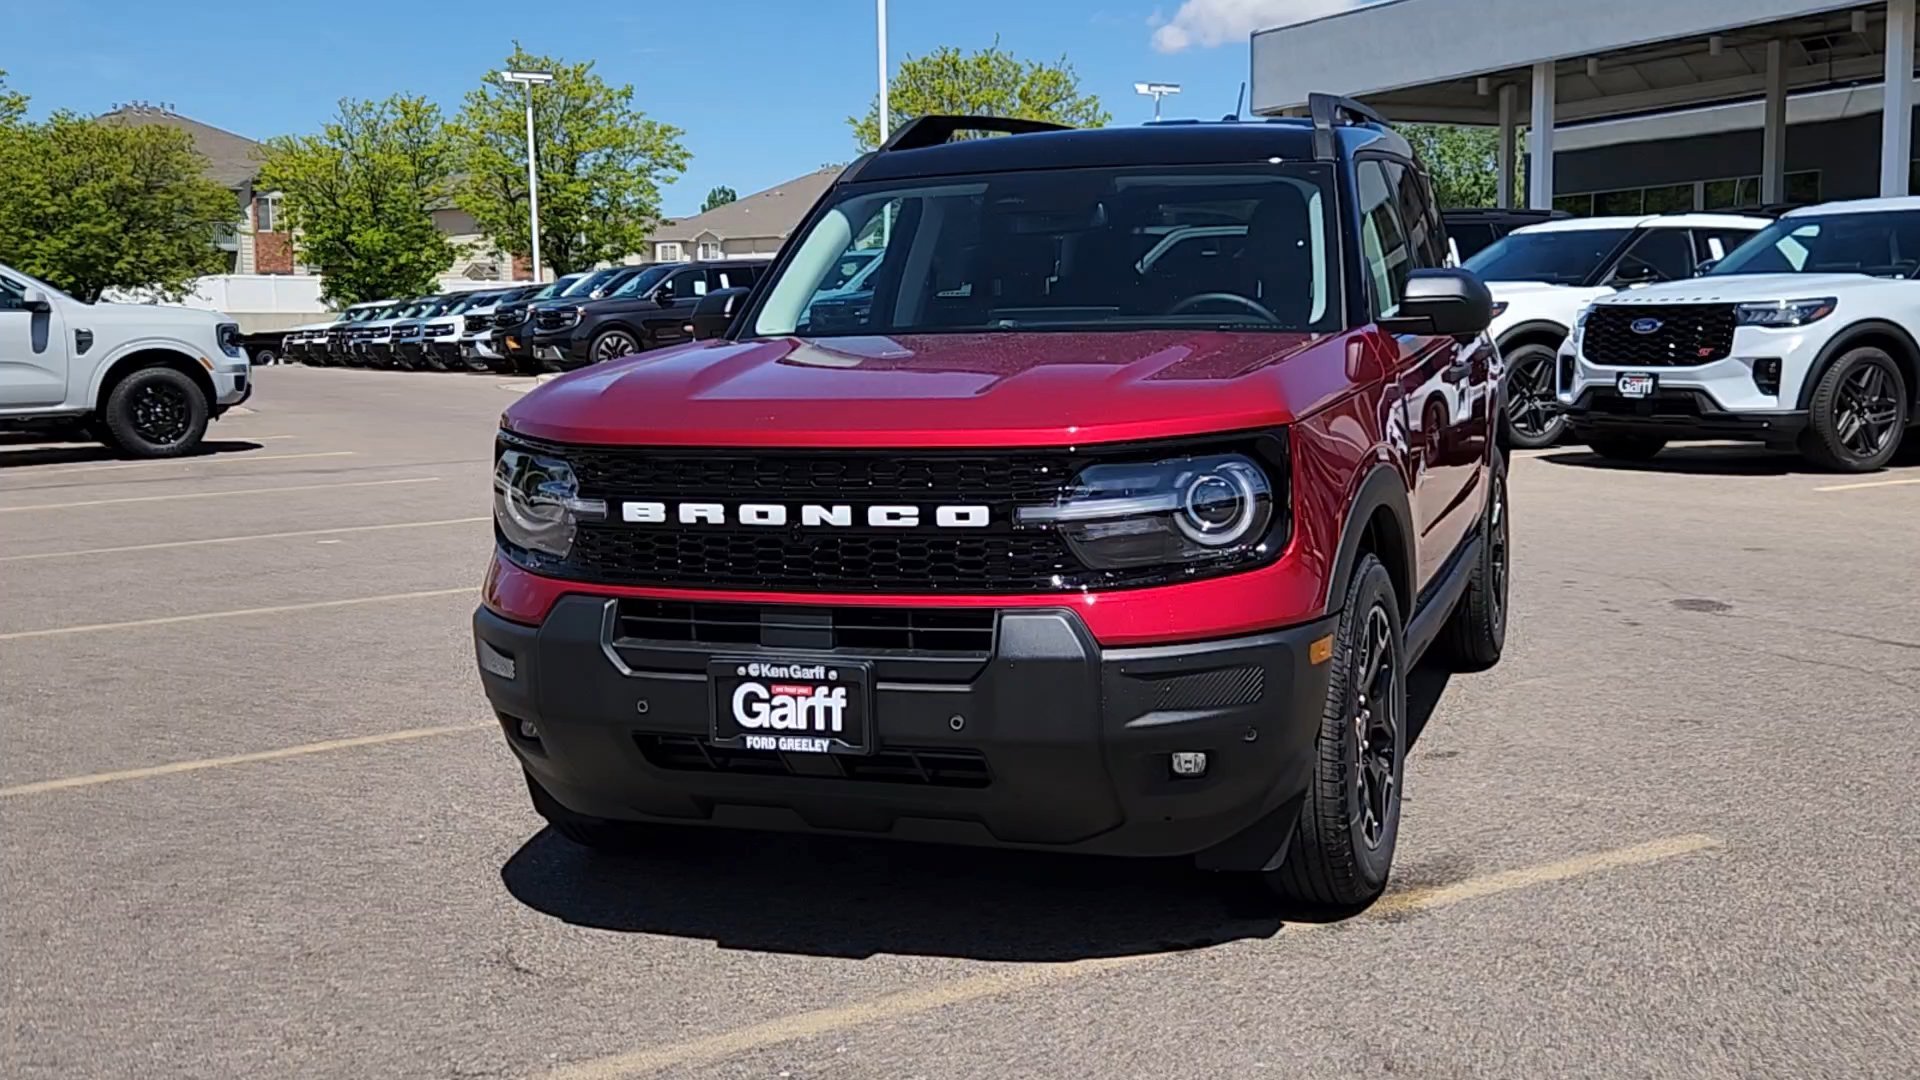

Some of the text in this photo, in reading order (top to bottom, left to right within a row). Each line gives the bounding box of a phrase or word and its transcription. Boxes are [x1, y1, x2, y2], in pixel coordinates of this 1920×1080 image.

[621, 501, 990, 527] BRONCO
[760, 663, 826, 679] Ken Garff
[732, 682, 847, 731] Garff
[746, 736, 830, 753] FORD GREELEY
